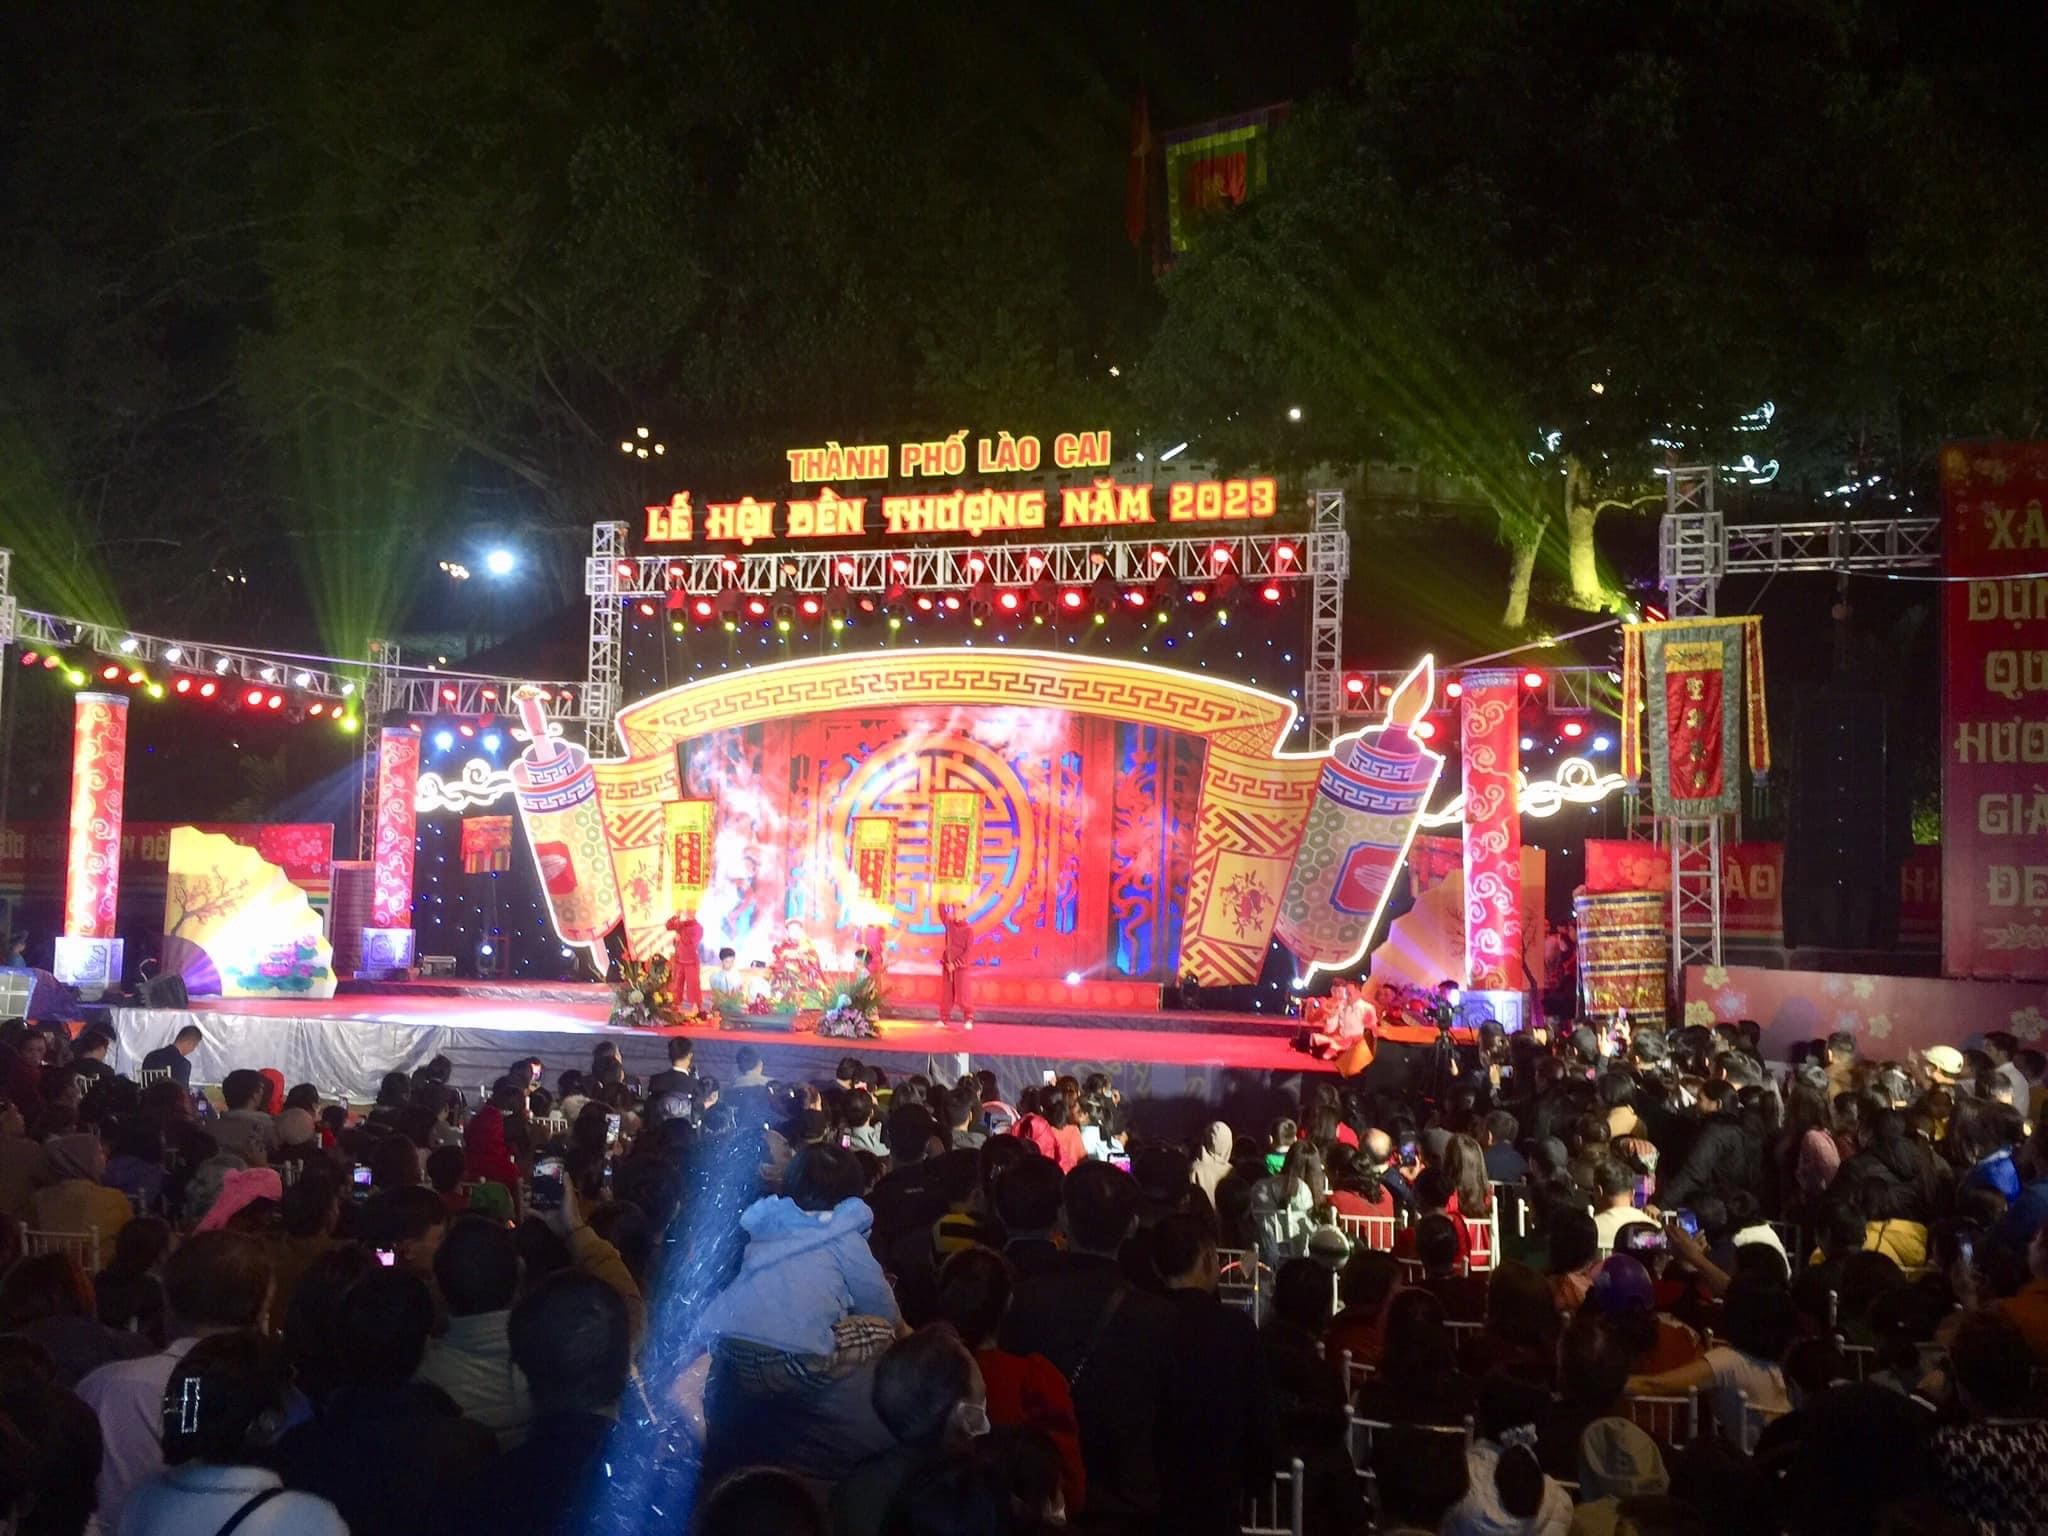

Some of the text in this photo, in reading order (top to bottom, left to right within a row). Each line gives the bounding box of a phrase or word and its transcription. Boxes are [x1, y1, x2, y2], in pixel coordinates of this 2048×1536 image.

[787, 430, 1111, 482] THÀNH PHỐ LÀO CAI
[705, 497, 776, 545] HỘI
[785, 486, 867, 537] ĐỀN
[882, 488, 1046, 537] THƯỢNG
[1060, 477, 1156, 527] NĂM
[1168, 478, 1278, 523] 2023
